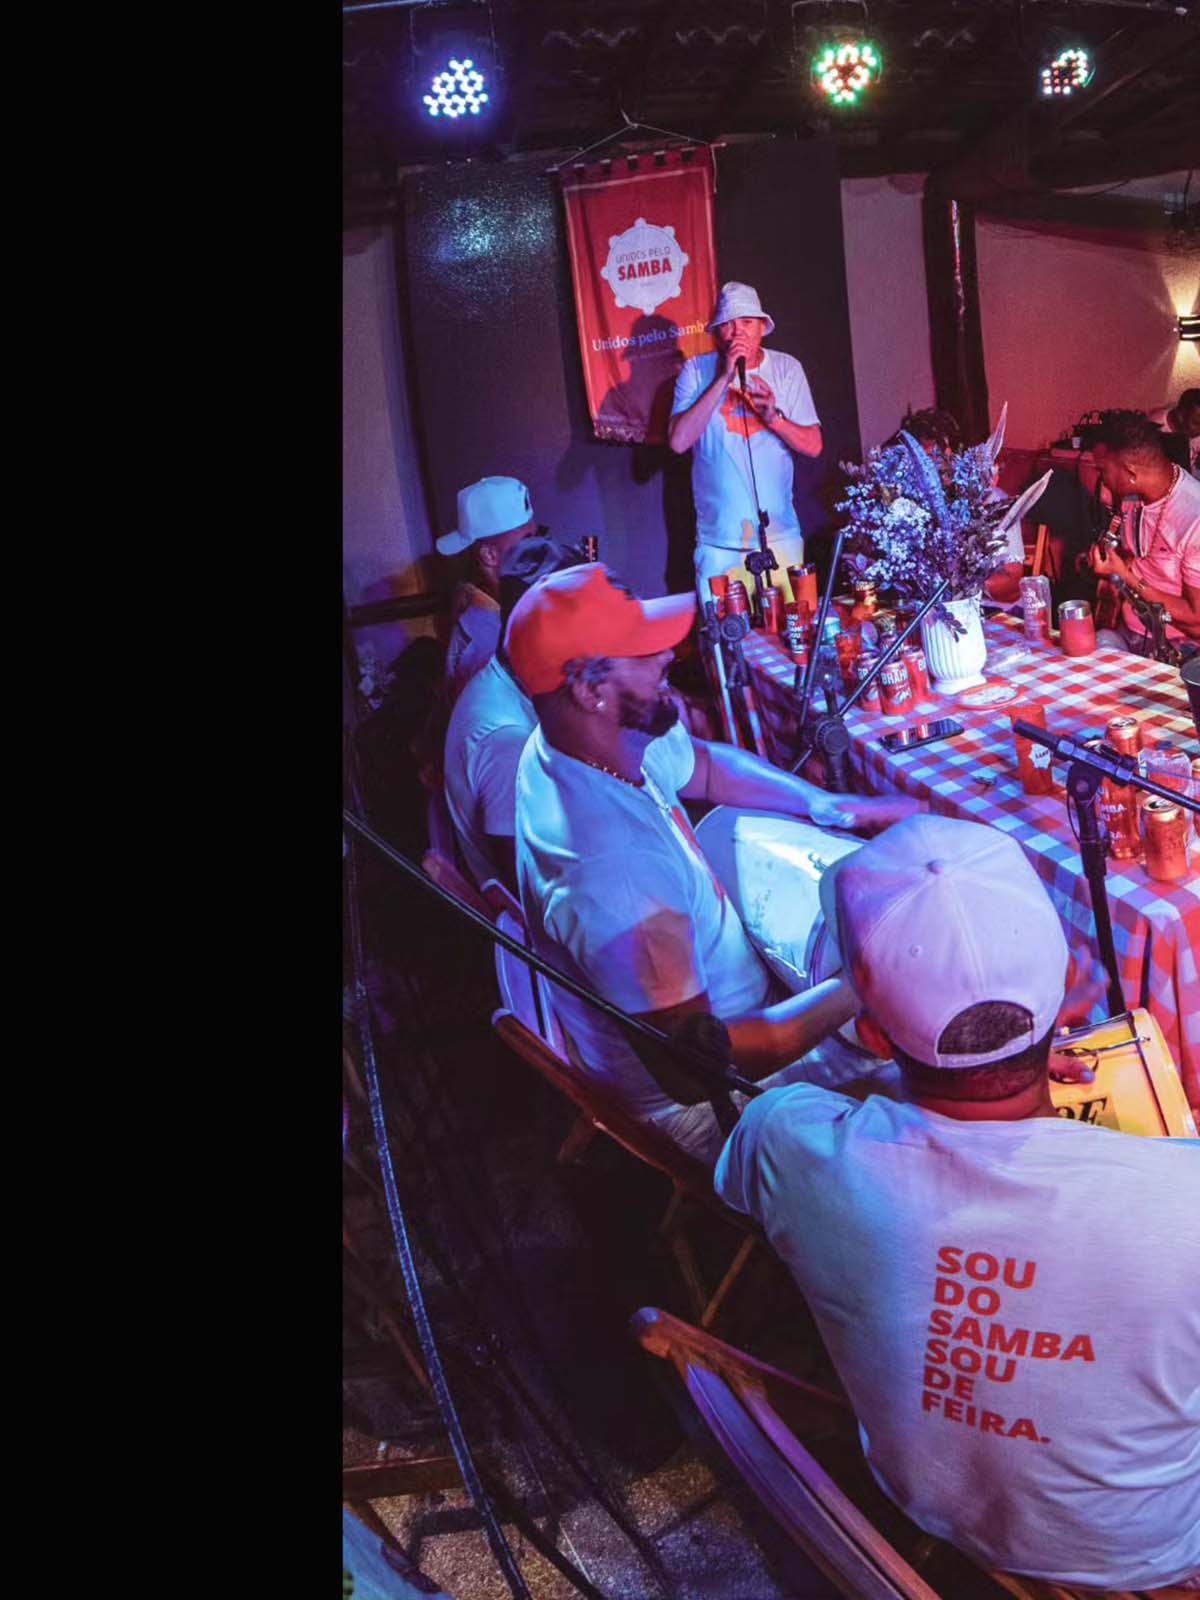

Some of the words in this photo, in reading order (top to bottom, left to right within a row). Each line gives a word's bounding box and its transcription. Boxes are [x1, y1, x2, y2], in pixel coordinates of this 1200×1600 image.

[618, 256, 672, 281] SAMBA
[592, 335, 638, 352] Unidos
[638, 328, 667, 346] pelo
[936, 1246, 1037, 1289] SOU
[934, 1277, 1001, 1316] DO
[928, 1309, 1096, 1362] SAMBA
[925, 1339, 1017, 1384] SOU
[923, 1366, 975, 1403] DE
[921, 1390, 1052, 1444] FEIRA.
